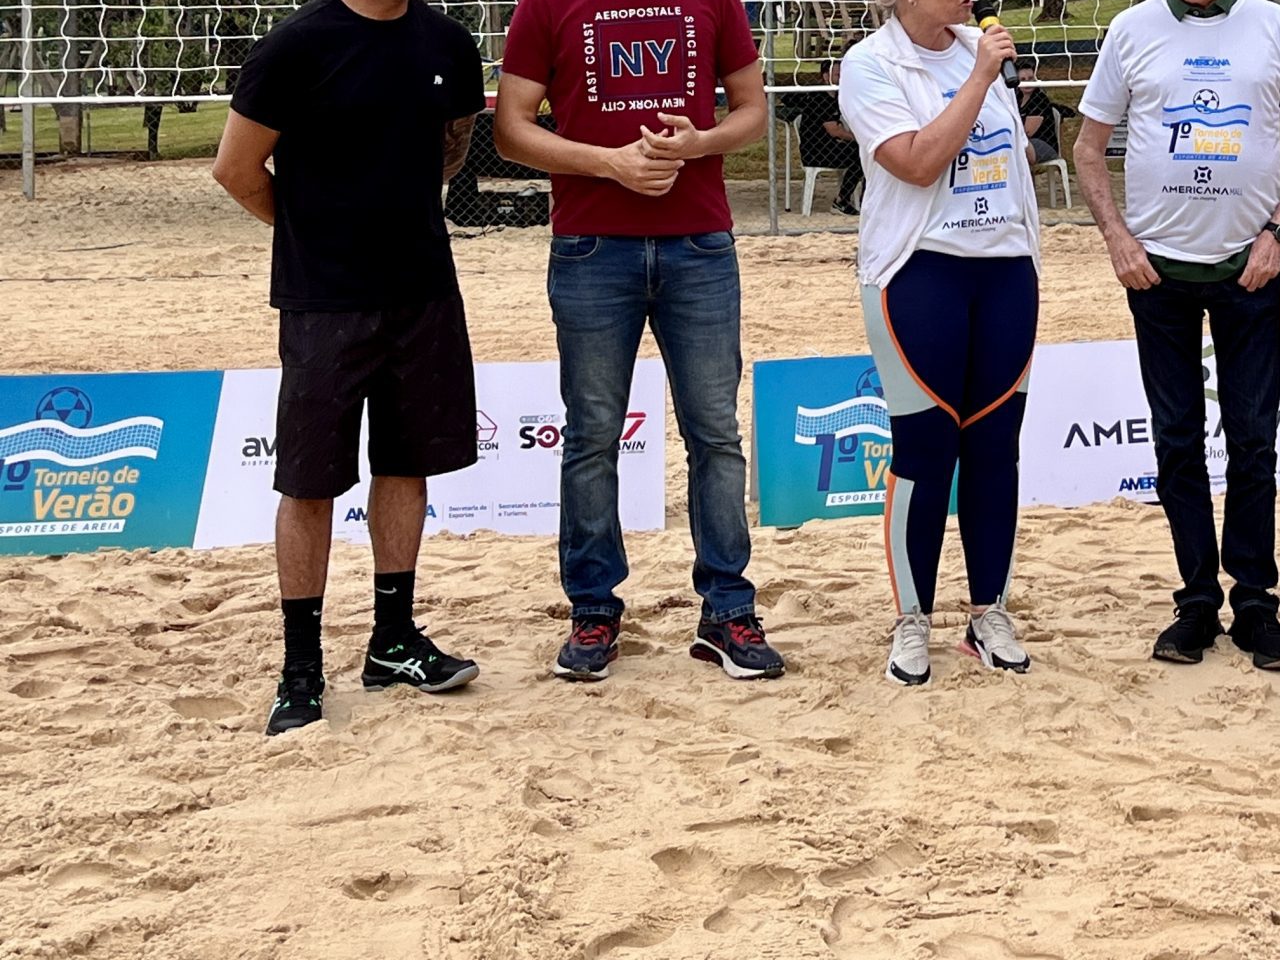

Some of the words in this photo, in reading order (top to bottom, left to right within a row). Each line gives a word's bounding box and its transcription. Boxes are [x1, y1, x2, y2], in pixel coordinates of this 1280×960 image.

[595, 6, 682, 21] AEROPOSTALE
[684, 15, 697, 57] SINCE
[582, 23, 596, 65] COAST
[610, 38, 677, 77] NY
[1183, 58, 1231, 67] AMERICANA
[586, 70, 598, 102] EAST
[686, 65, 697, 97] 1987
[601, 101, 627, 112] CITY
[629, 99, 660, 111] YORK
[662, 98, 686, 109] NEW
[1194, 139, 1242, 154] Verão
[971, 164, 1009, 184] Verão
[1162, 185, 1229, 196] AMERICANA
[942, 216, 1006, 230] AMERICANA
[35, 467, 110, 487] Torneio
[113, 465, 140, 483] de
[34, 486, 135, 520] Verão
[830, 493, 886, 504] ESPORTES
[61, 523, 78, 532] DE
[82, 522, 120, 531] AREIA
